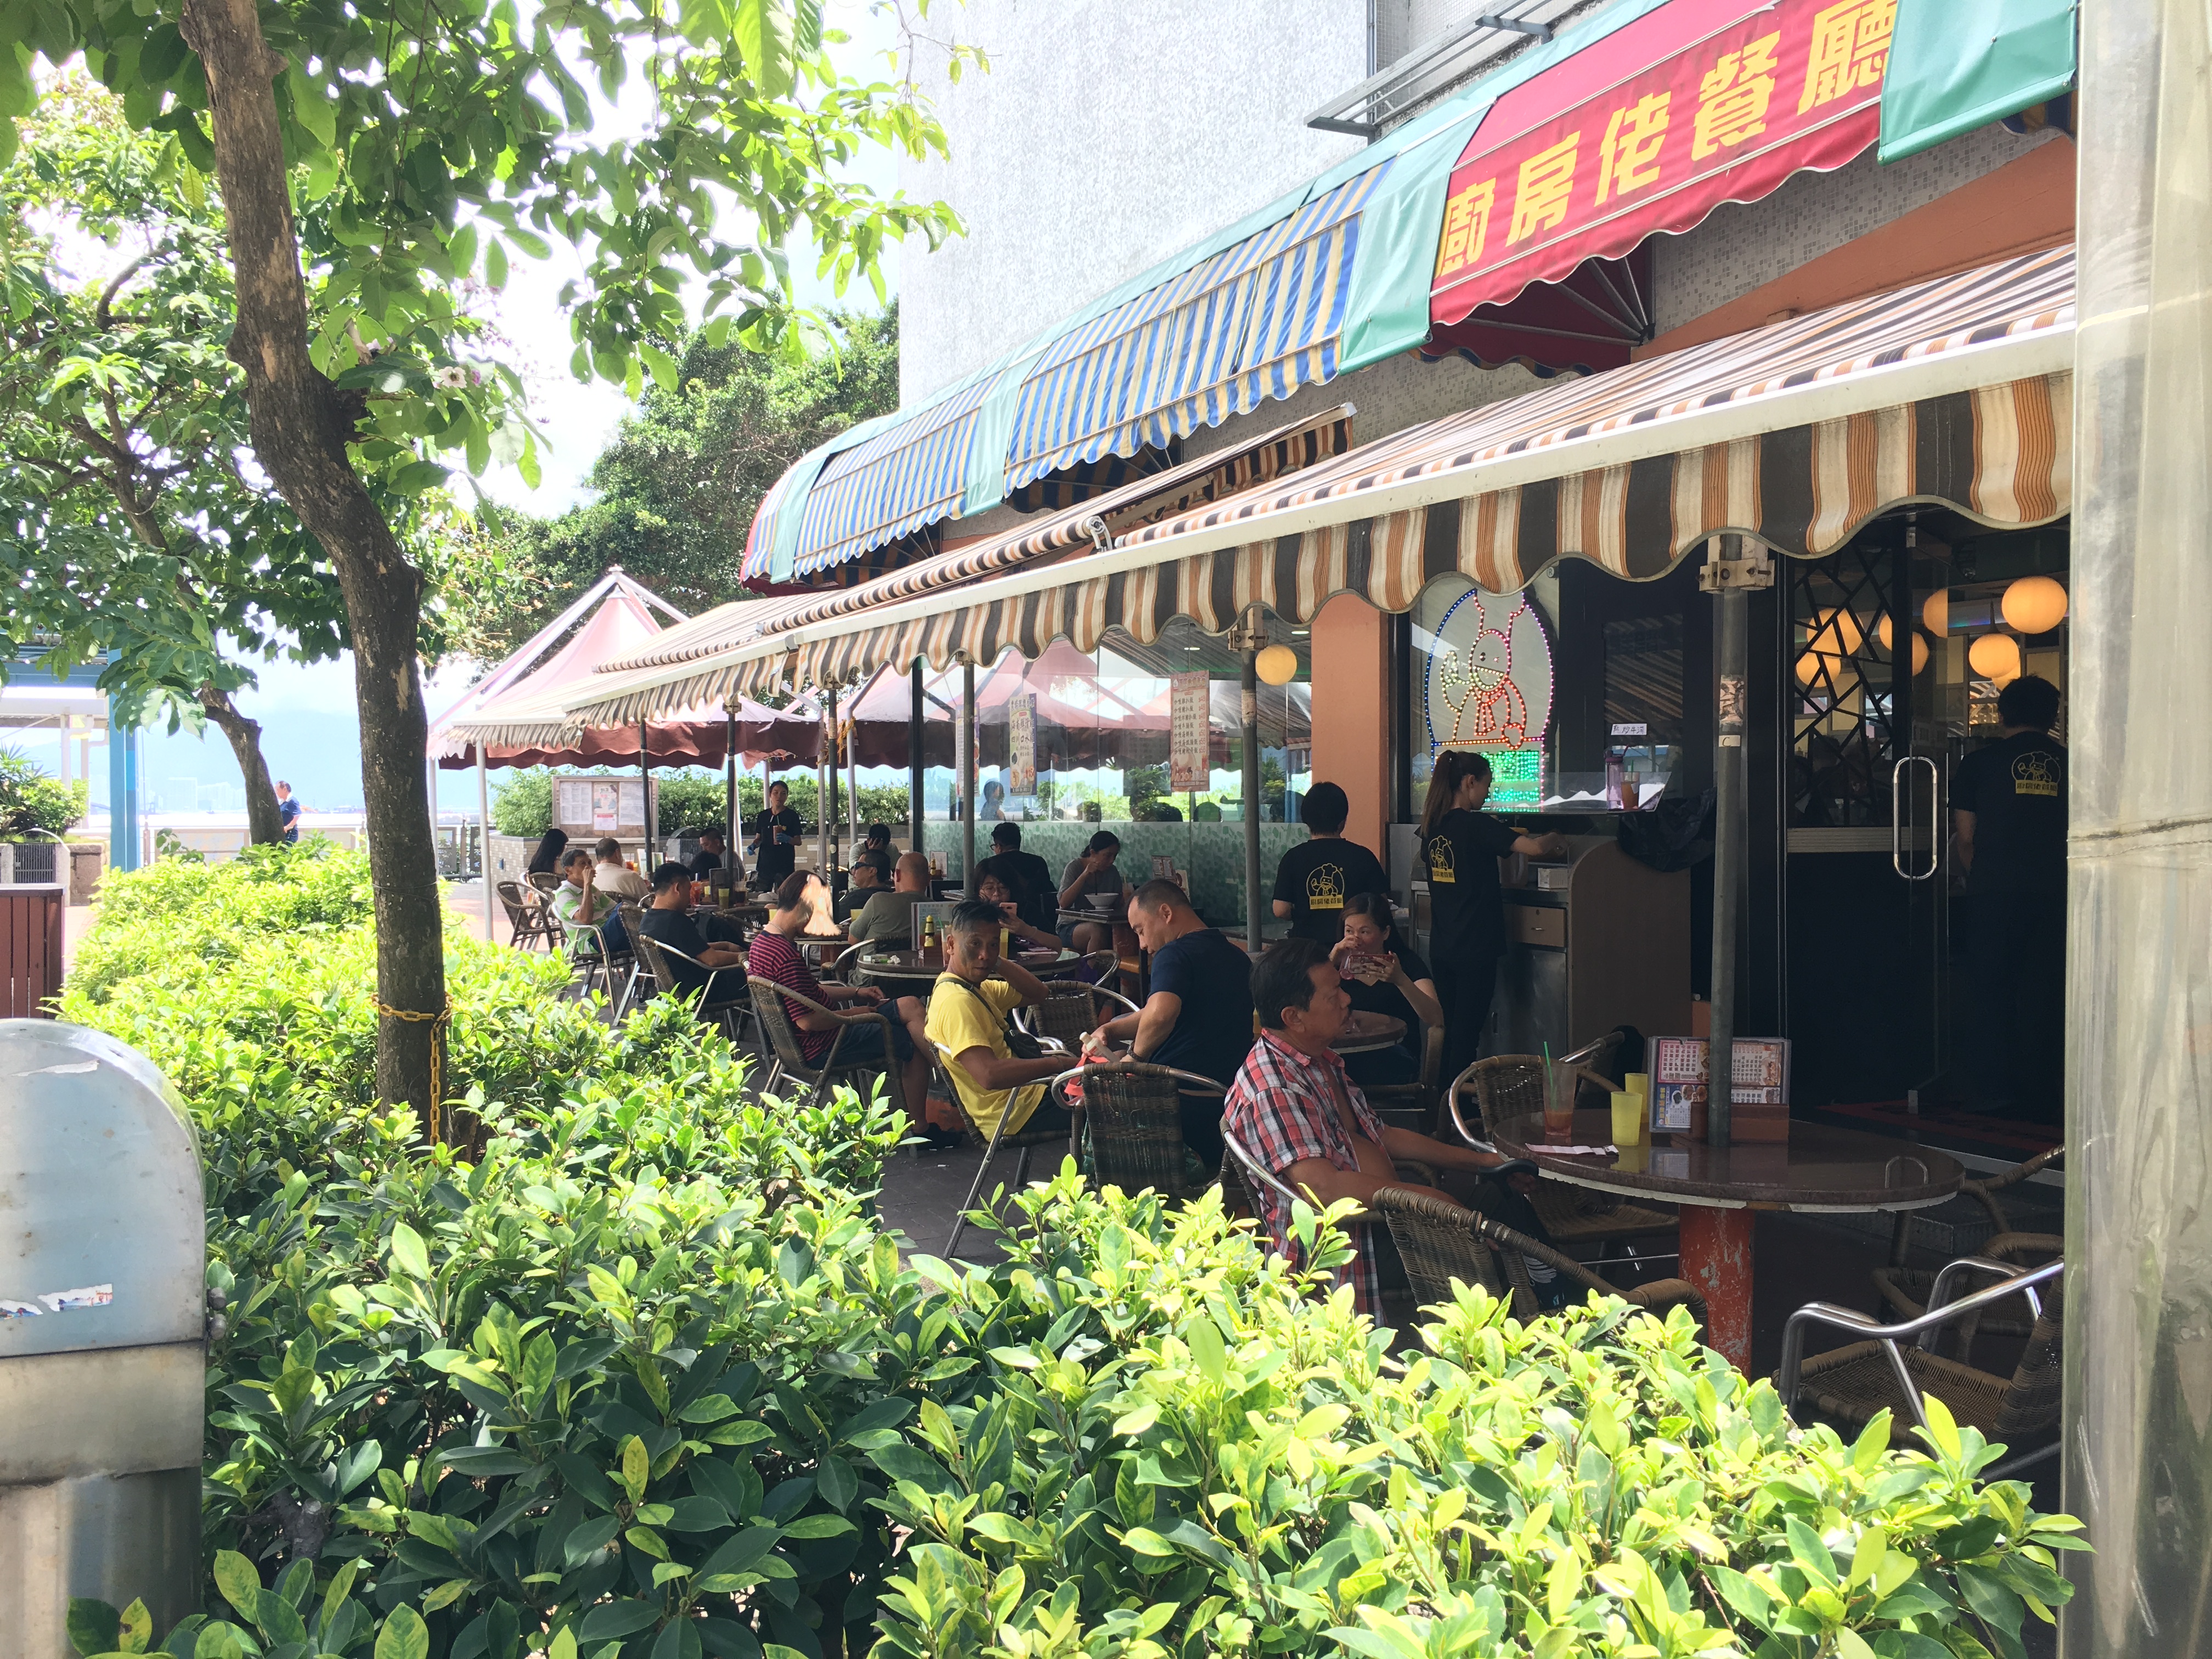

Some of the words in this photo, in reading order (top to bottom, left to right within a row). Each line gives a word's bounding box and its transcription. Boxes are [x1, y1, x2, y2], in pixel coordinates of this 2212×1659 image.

[1435, 0, 1898, 279] 廚房佬餐廳
